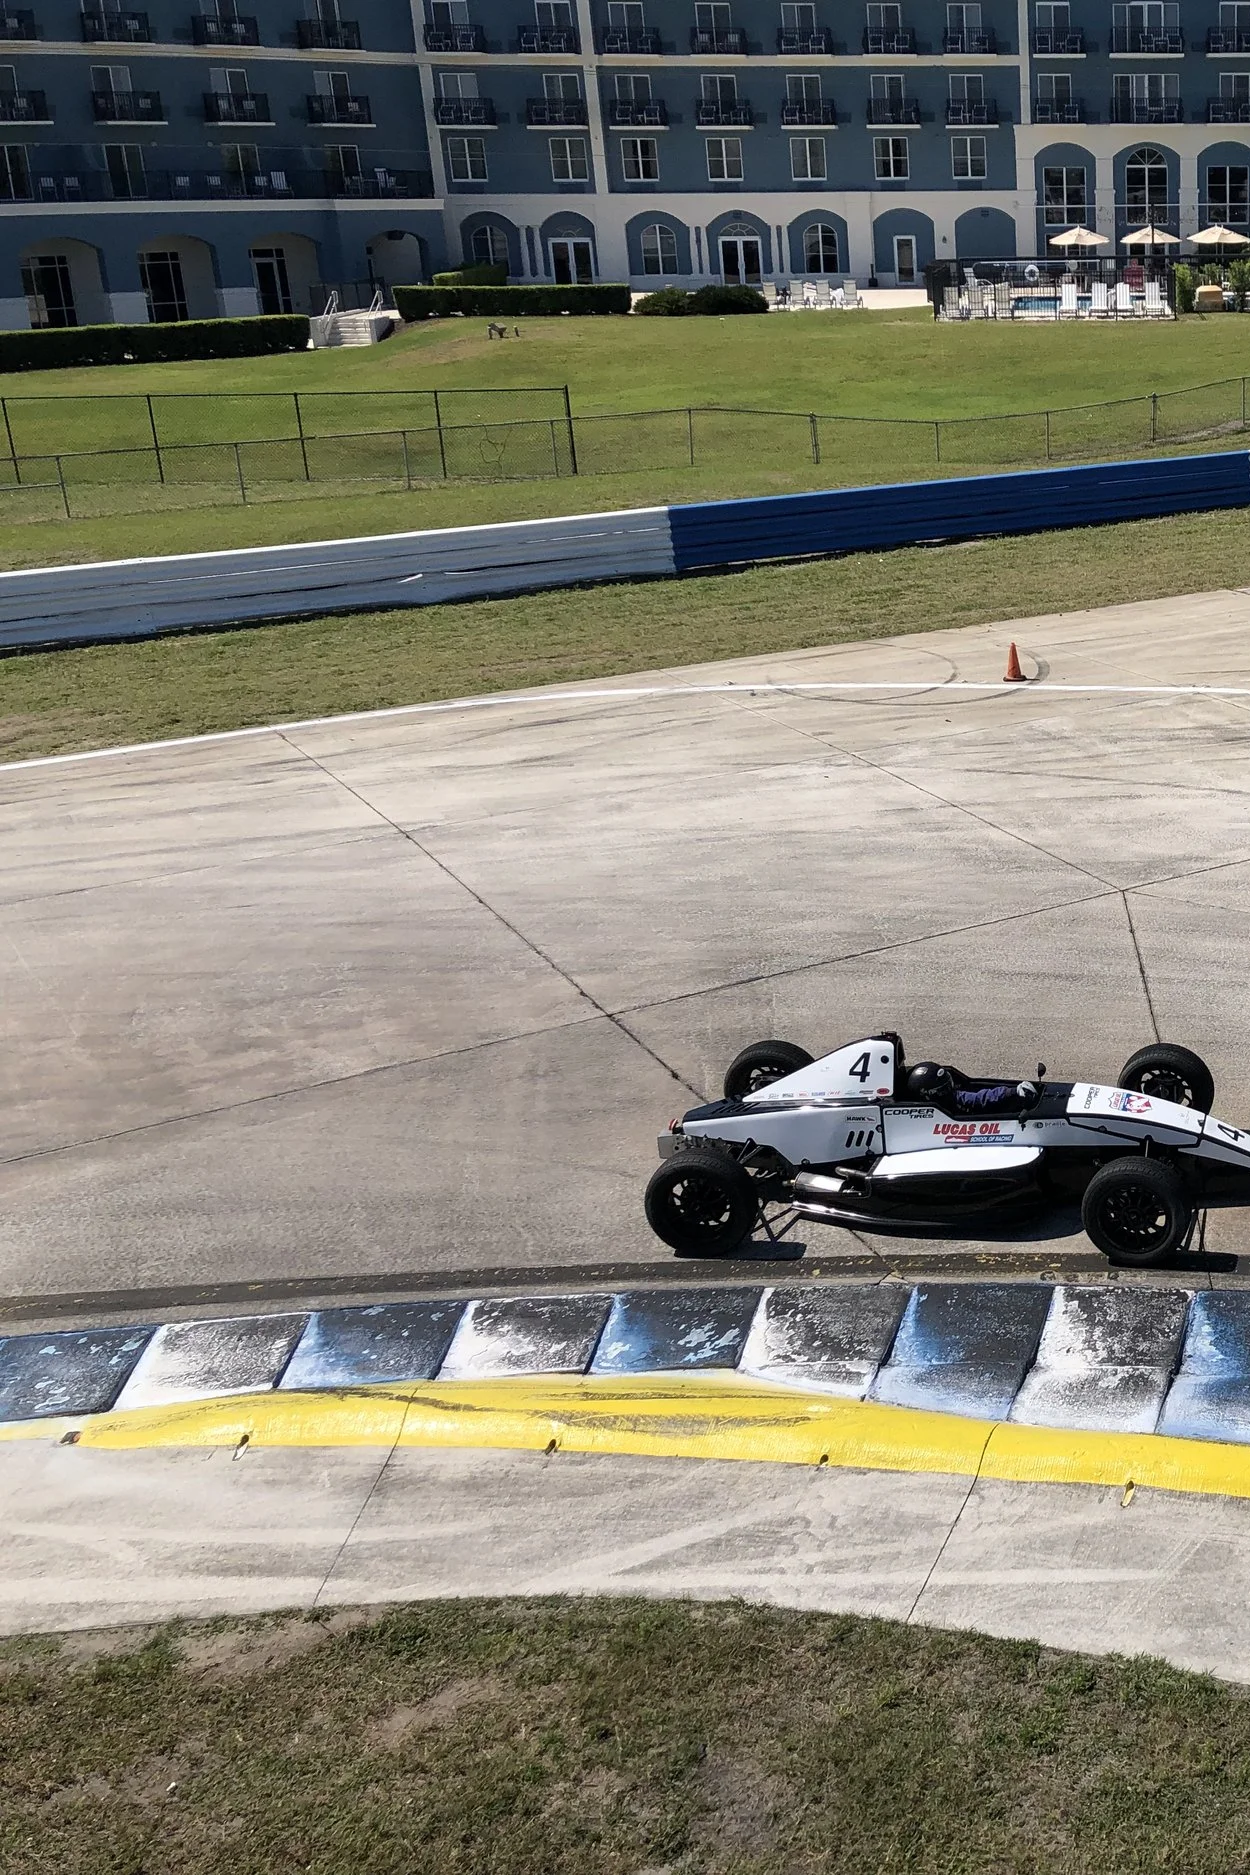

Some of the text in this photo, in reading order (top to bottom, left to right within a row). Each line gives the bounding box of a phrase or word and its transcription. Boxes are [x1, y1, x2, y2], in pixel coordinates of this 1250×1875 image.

[849, 1052, 871, 1083] 4
[884, 1108, 935, 1116] COOPER
[933, 1122, 1001, 1135] LUCAS OIL
[1217, 1123, 1245, 1142] 4
